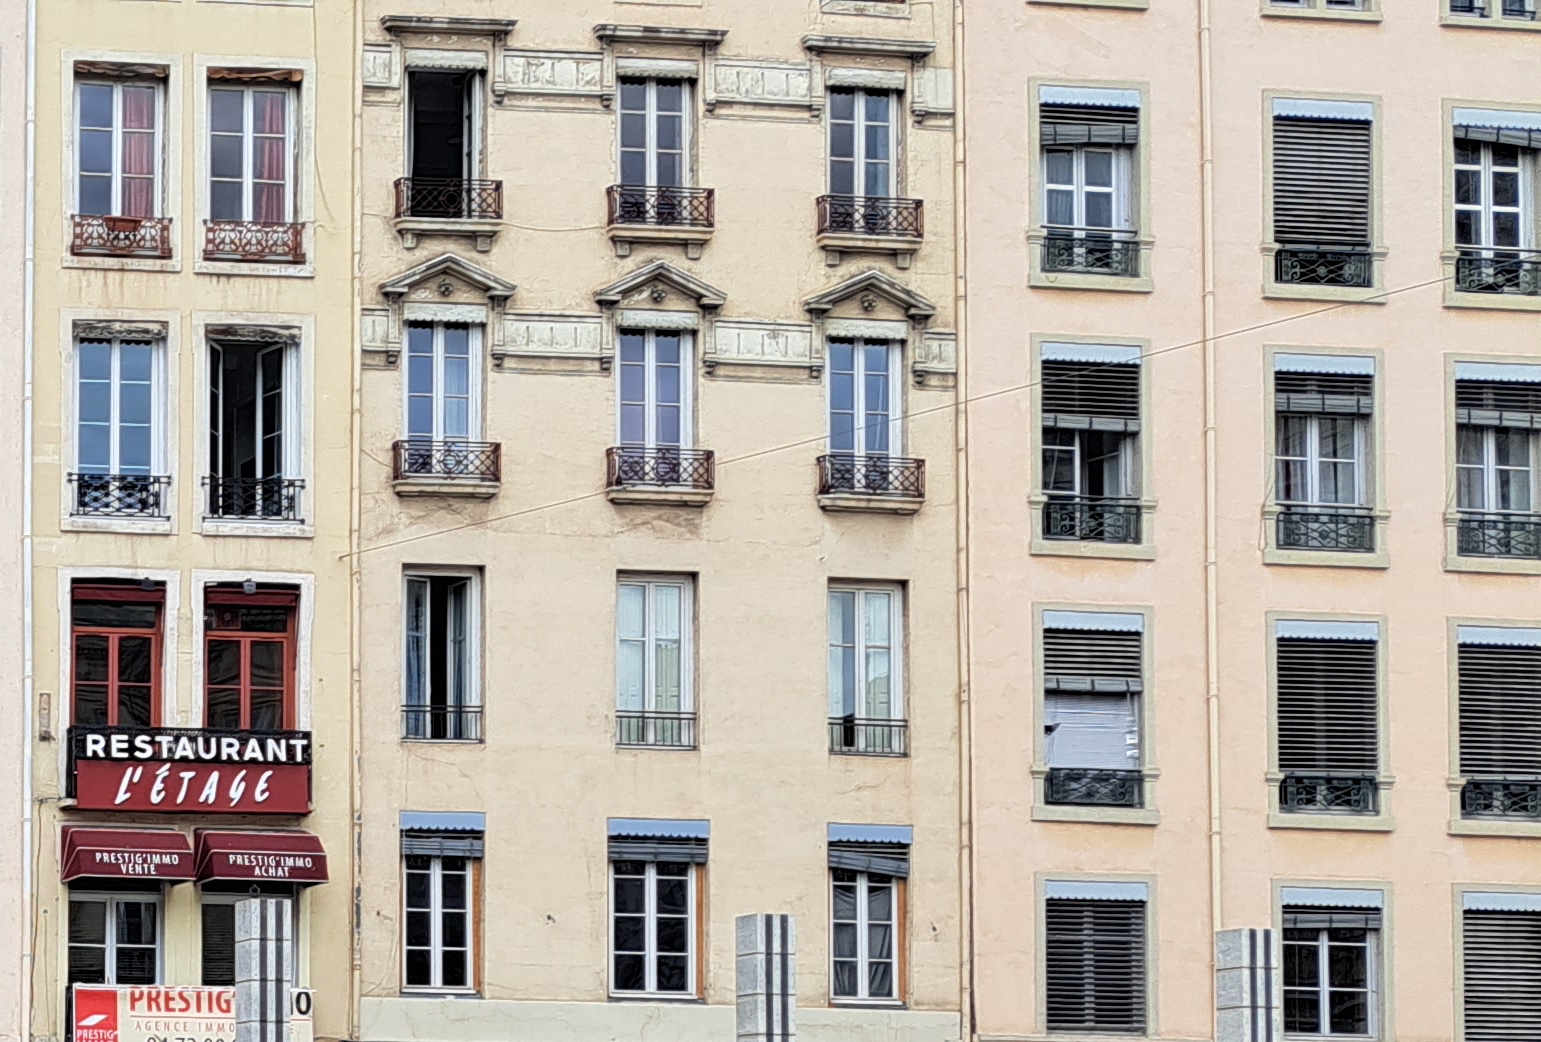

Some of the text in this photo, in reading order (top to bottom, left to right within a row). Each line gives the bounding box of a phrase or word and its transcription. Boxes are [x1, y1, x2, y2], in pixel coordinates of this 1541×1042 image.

[85, 734, 308, 762] RESTAURANT
[114, 763, 273, 807] L'ÉTAGE
[95, 852, 179, 865] PRESTIG'IMMO
[229, 854, 313, 868] PRESTIG'IMMO
[120, 863, 156, 875] VENTE
[254, 865, 290, 878] ACHAT
[135, 1020, 189, 1032] AGENCE
